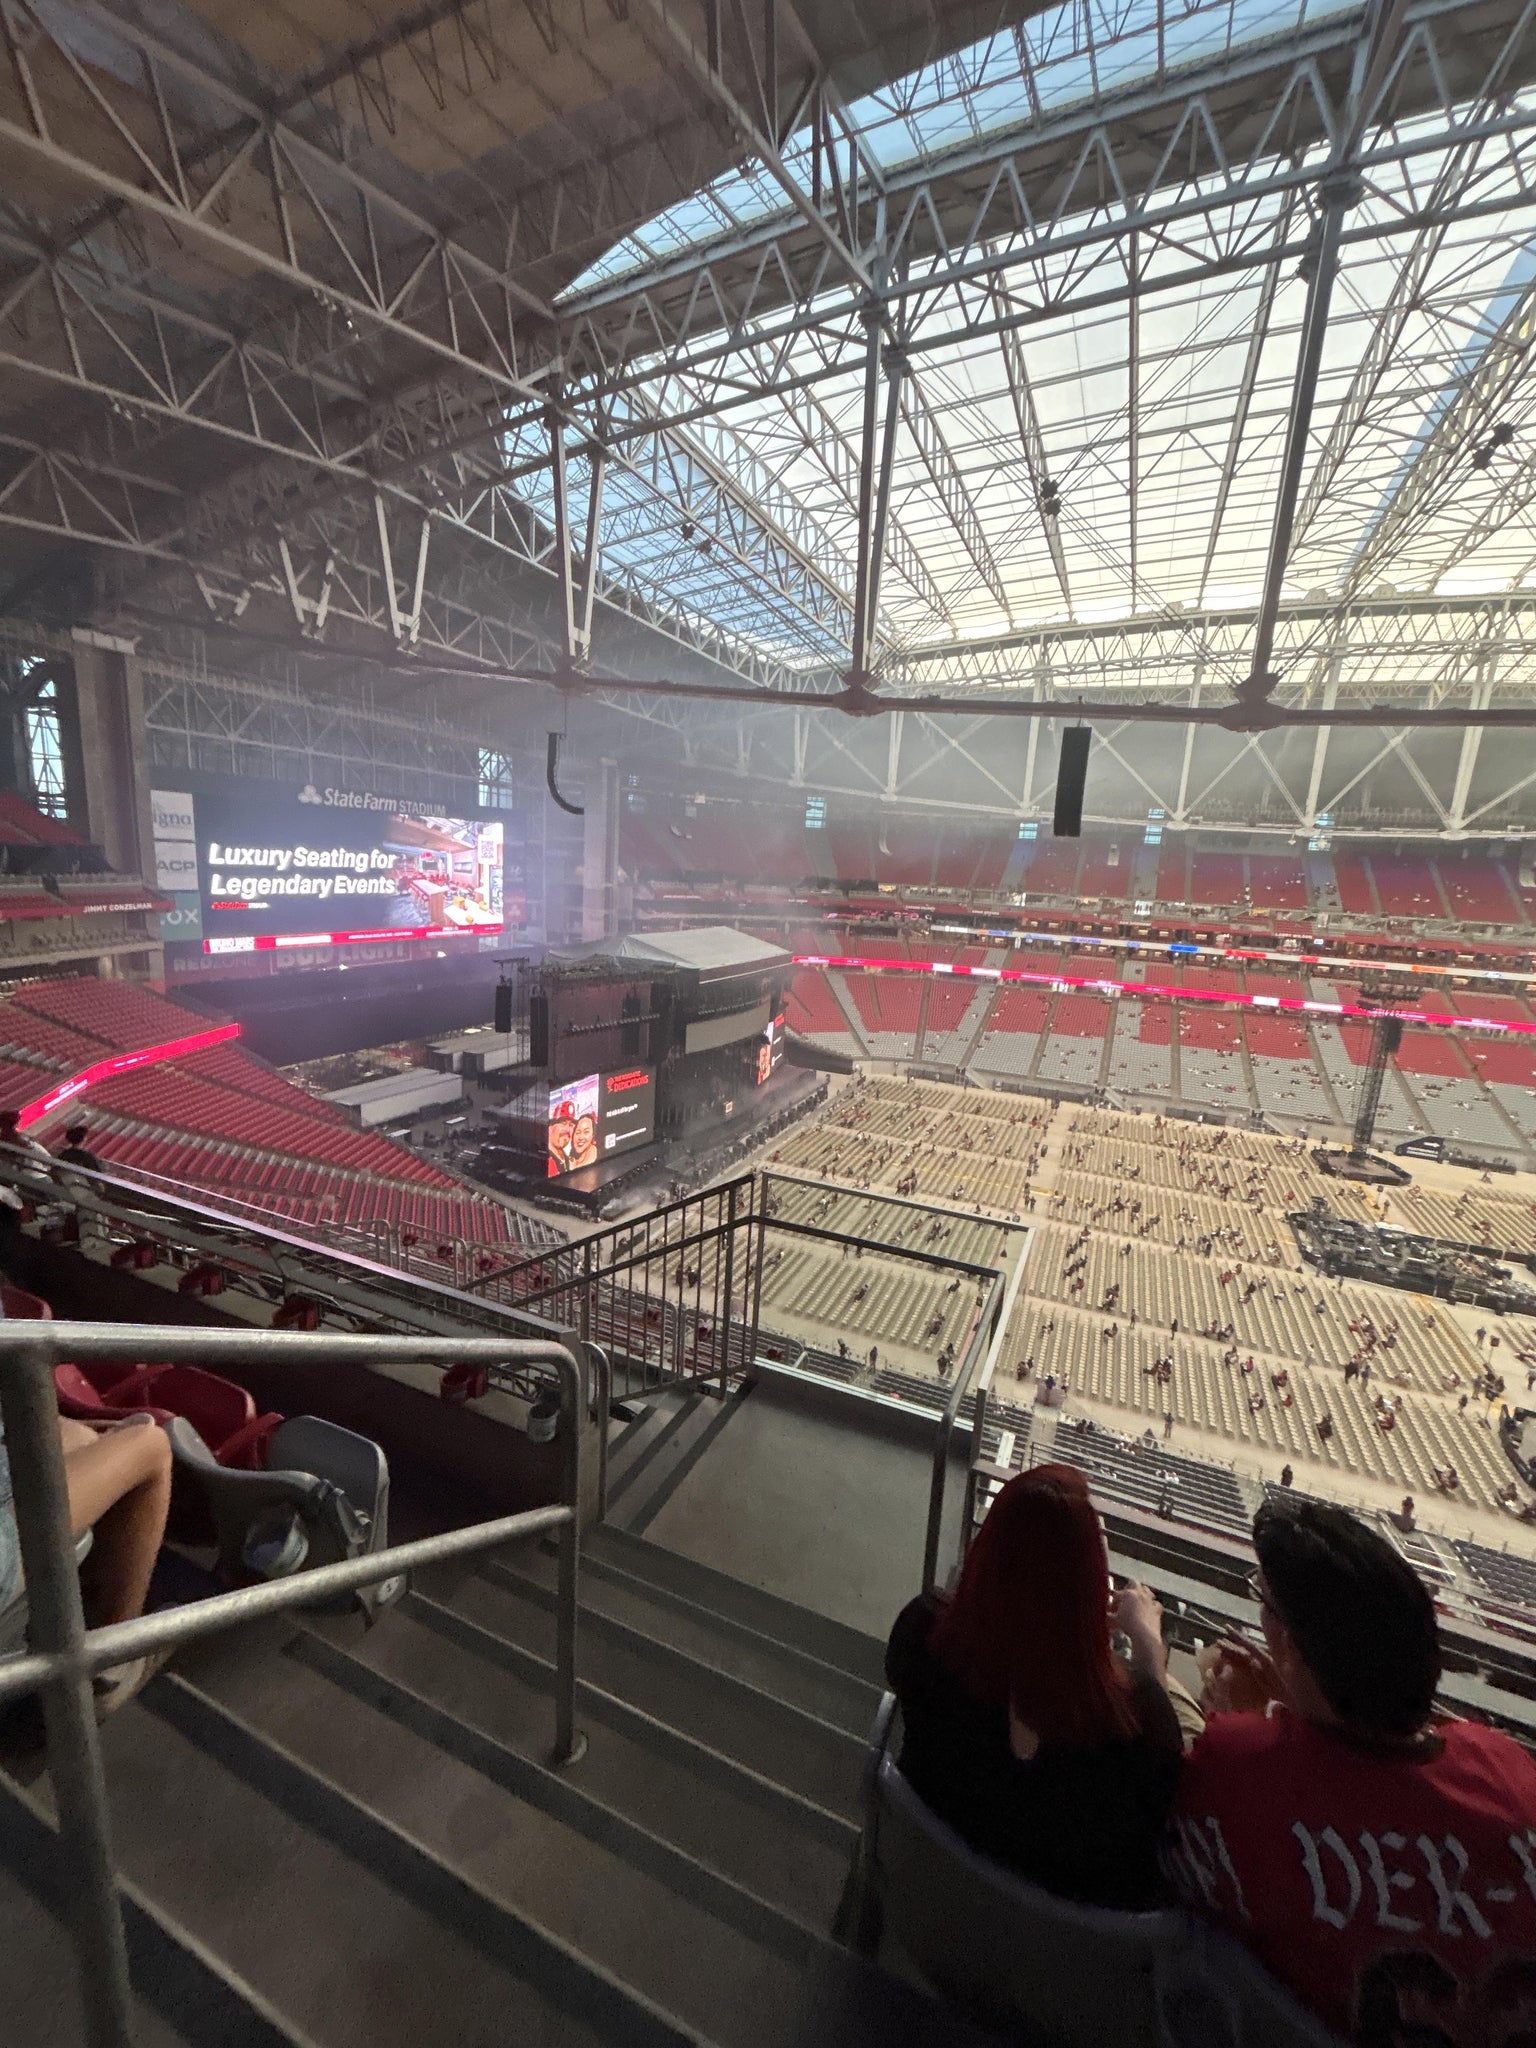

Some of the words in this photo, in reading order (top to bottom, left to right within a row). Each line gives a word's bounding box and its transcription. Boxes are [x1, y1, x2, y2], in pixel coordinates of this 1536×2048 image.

[399, 800, 446, 817] STADIUM
[153, 808, 192, 828] igna
[208, 842, 292, 871] Luxury
[293, 846, 369, 873] Seating
[370, 849, 397, 869] for
[210, 873, 333, 899] Legendary
[334, 875, 397, 895] Events
[83, 904, 108, 914] JIMMY
[109, 902, 153, 912] CONZELMAN
[160, 909, 199, 926] OX
[277, 947, 335, 969] BUD
[340, 944, 408, 963] LIGHT
[614, 1075, 649, 1092] DEDICATIONS
